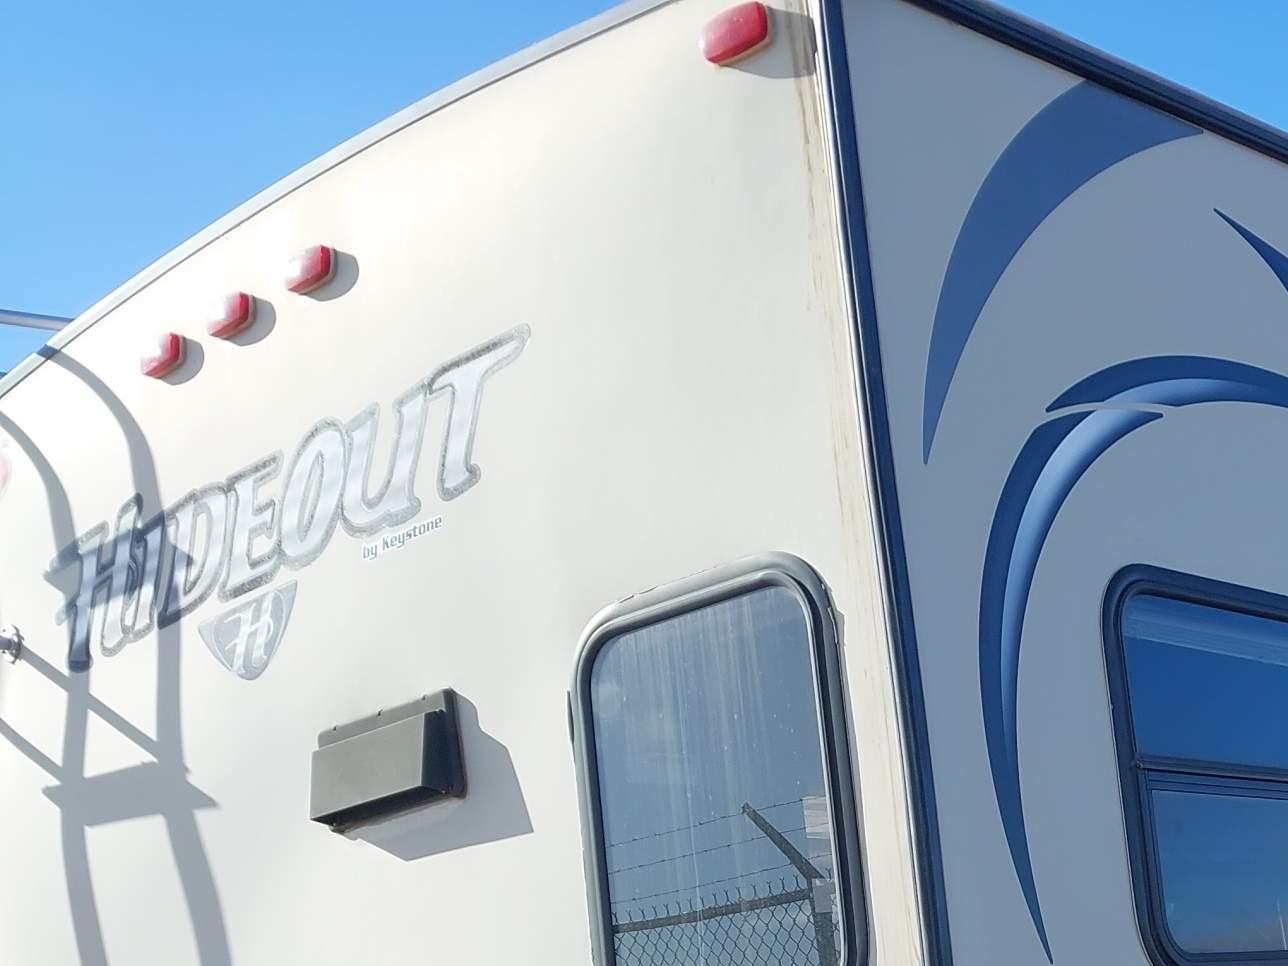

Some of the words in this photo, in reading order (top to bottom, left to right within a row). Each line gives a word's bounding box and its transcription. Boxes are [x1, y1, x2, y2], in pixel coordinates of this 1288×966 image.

[43, 322, 531, 672] HIDEOUT
[362, 544, 378, 560] by
[382, 516, 443, 550] Keystone
